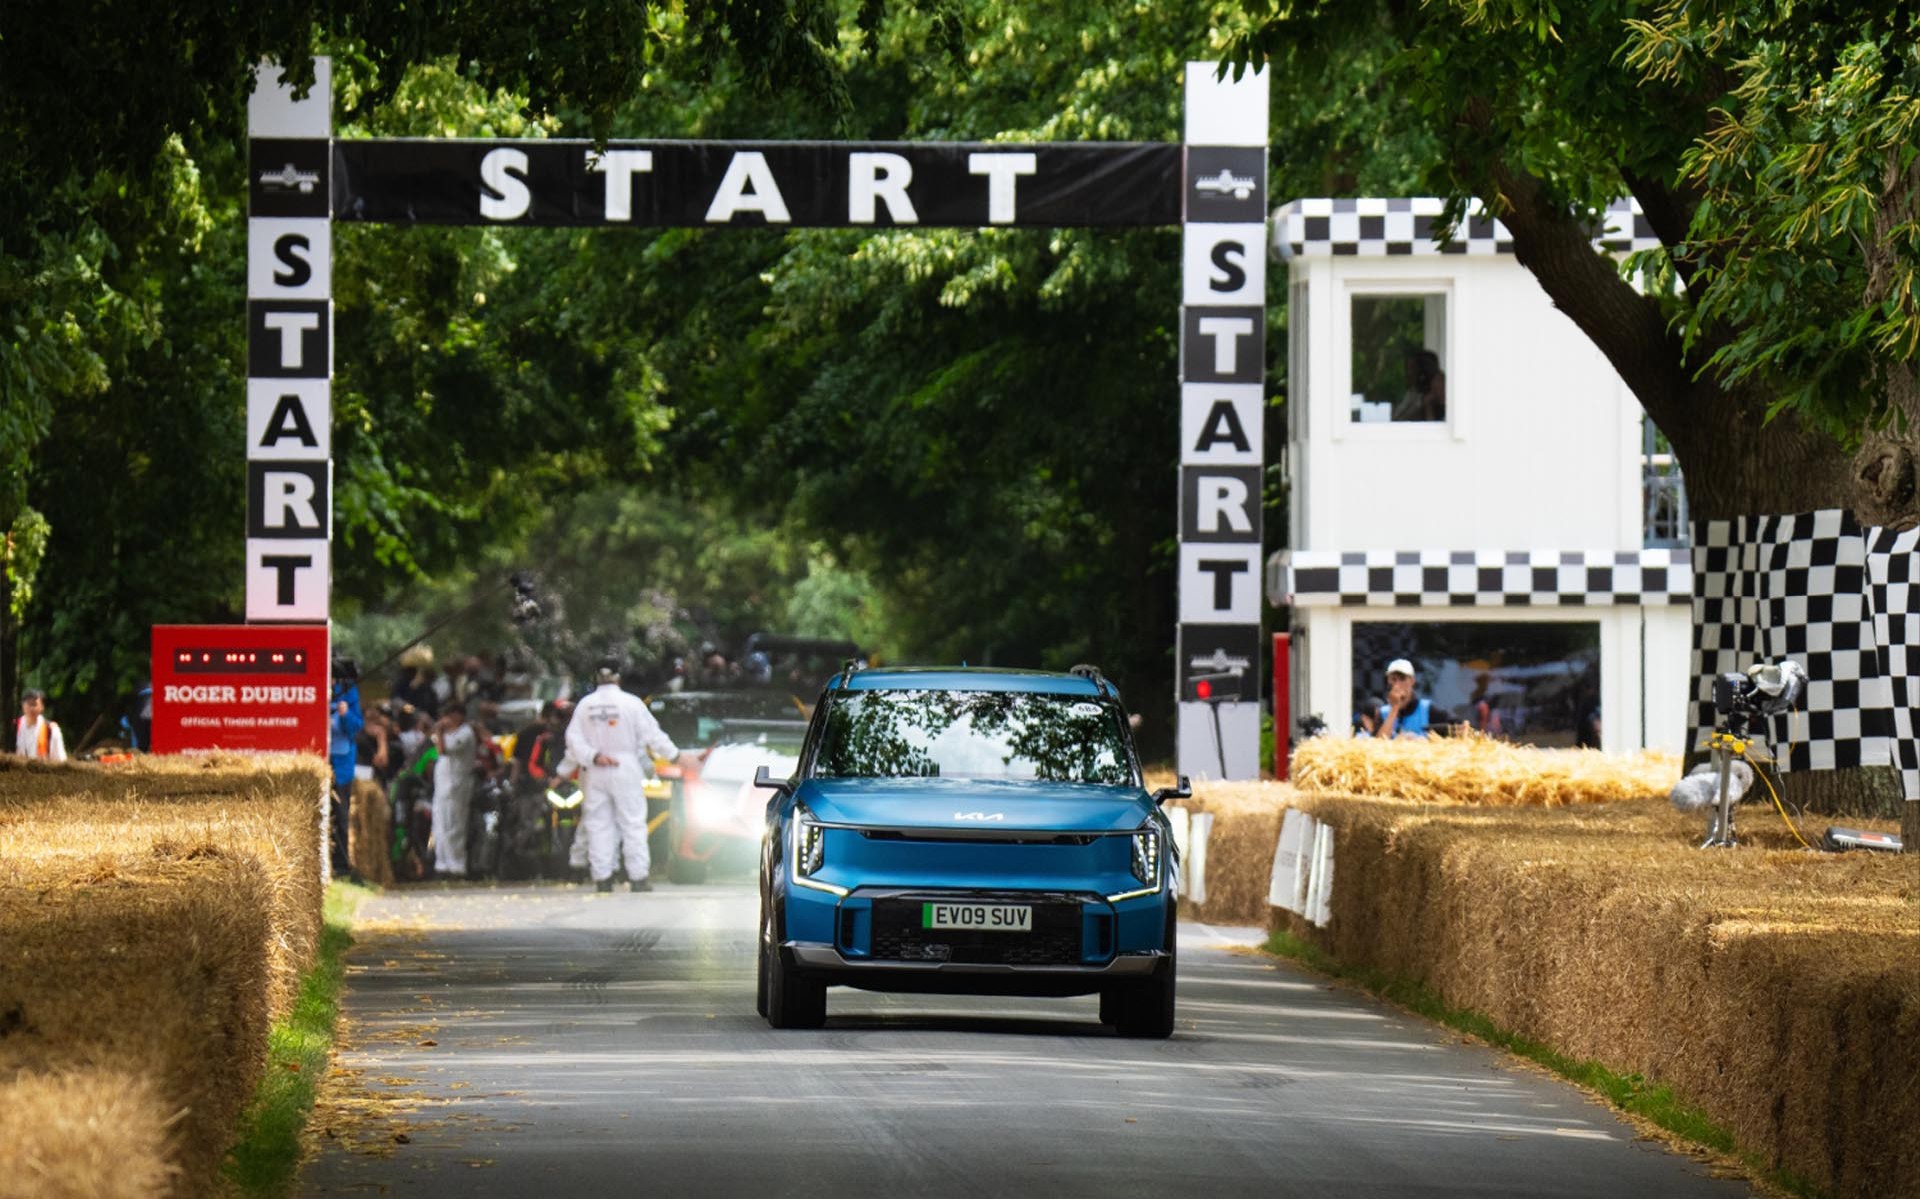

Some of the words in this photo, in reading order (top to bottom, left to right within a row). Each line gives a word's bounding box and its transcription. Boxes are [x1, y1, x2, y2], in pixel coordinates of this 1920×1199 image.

[479, 147, 1037, 225] START
[258, 232, 321, 607] START
[1194, 239, 1254, 612] START
[165, 686, 236, 702] ROGER
[240, 686, 316, 702] DUBUIS
[180, 717, 221, 728] OFFICIAL
[223, 717, 256, 728] TIMING
[257, 717, 298, 728] PARTNER
[954, 812, 1004, 821] KIA
[936, 907, 985, 924] EV09
[991, 908, 1028, 926] SUV
